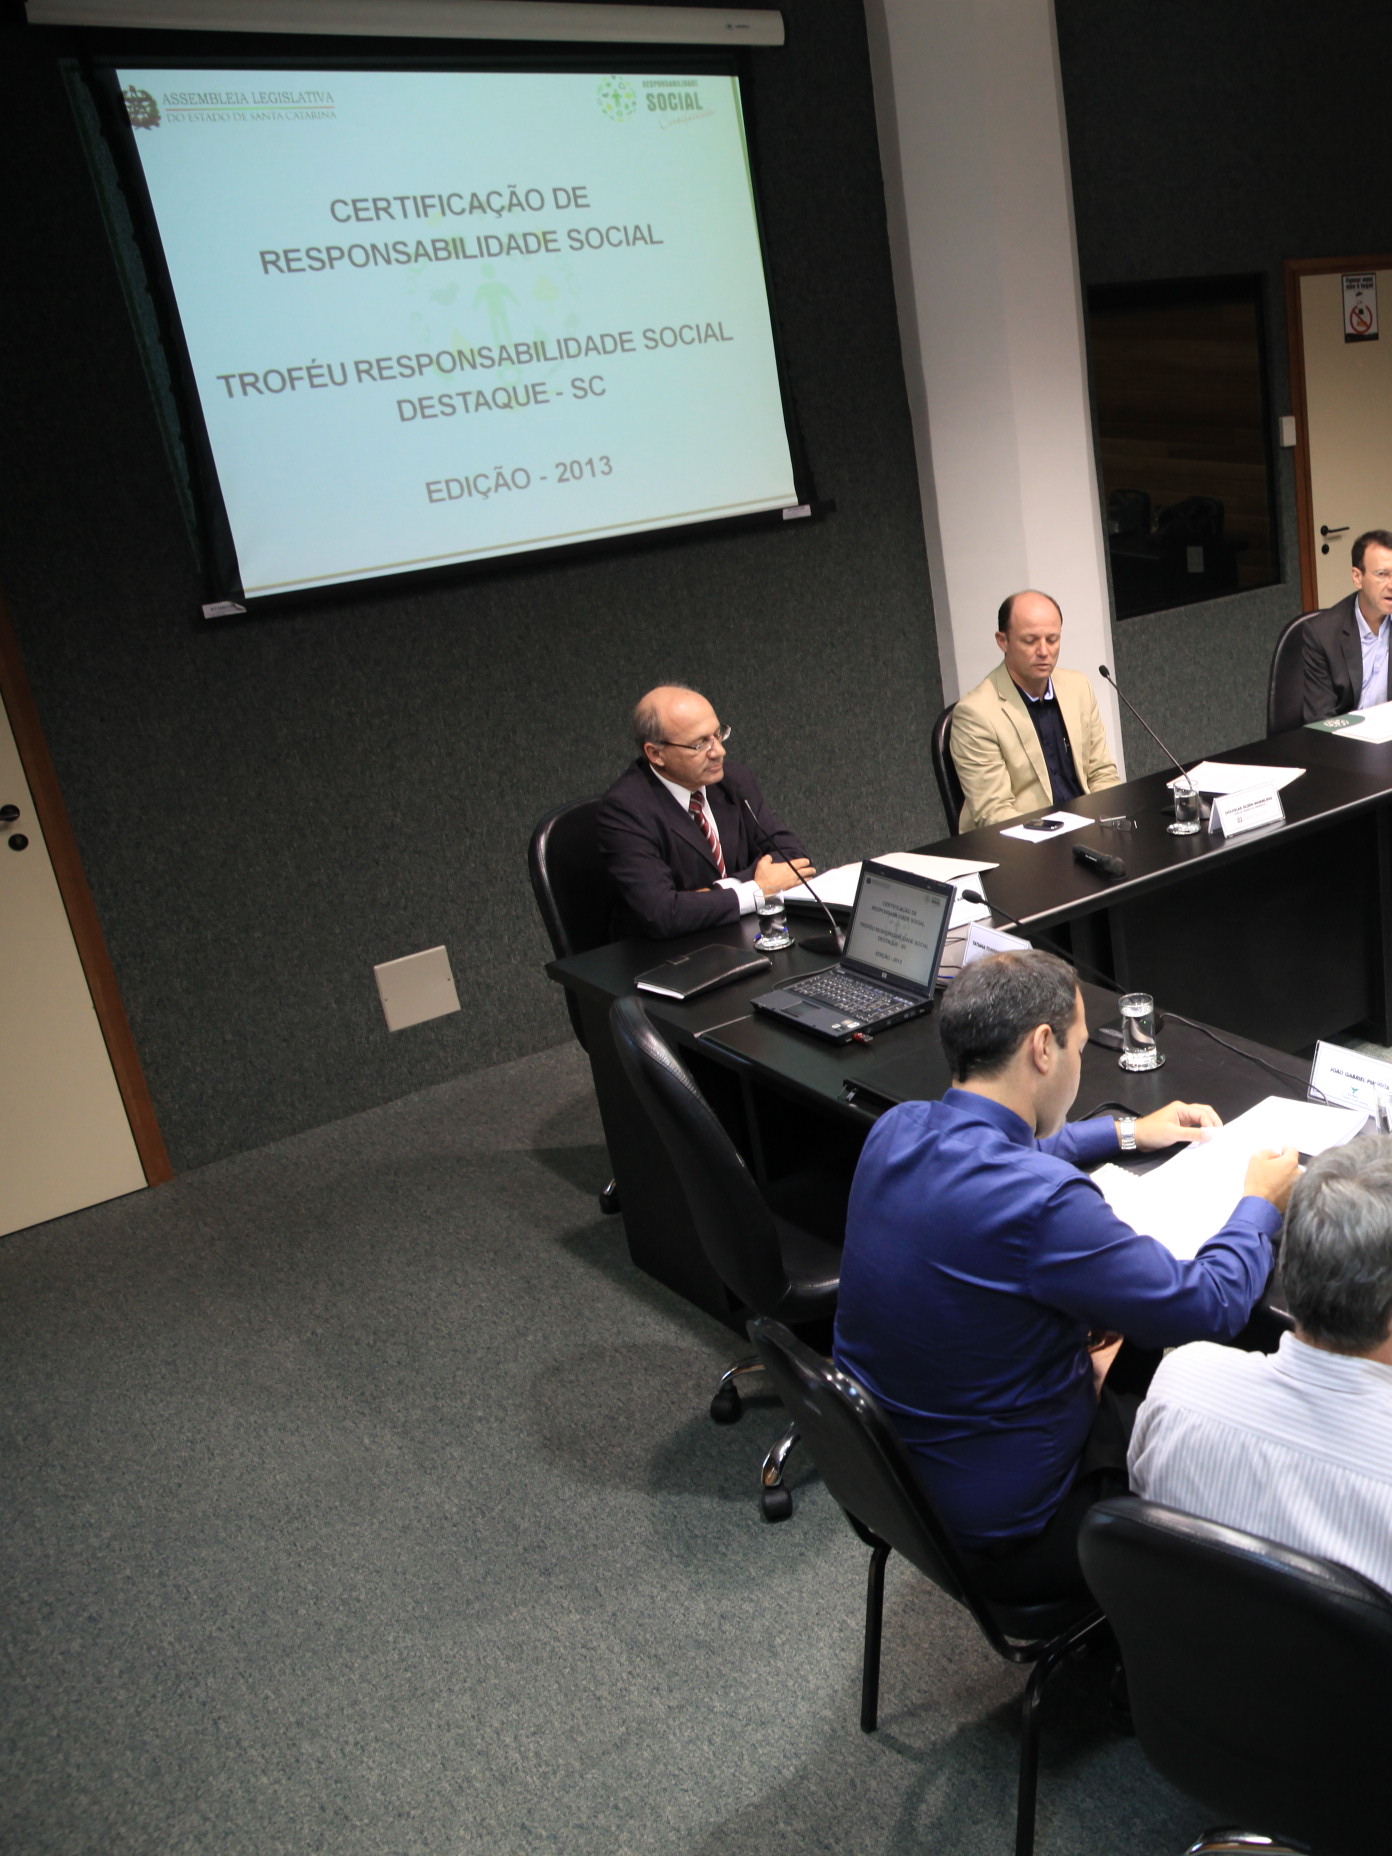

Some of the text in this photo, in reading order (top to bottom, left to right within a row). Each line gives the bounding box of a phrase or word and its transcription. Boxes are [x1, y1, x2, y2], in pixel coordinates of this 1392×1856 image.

[162, 90, 335, 106] ASSEMBLEIA LEGISLATIVA
[166, 110, 337, 123] DO ESTADO DE SANTA CATARINA
[645, 91, 704, 112] SOCIAL
[330, 184, 591, 223] CERTIFICAÇÃO DE
[258, 223, 664, 275] RESPONSABILIDADE SOCIAL
[216, 321, 734, 400] TROFÉU RESPONSABILIDADE SOCIAL
[396, 381, 551, 422] DESTAQUE
[570, 375, 608, 400] SC
[425, 465, 532, 504] EDIÇÃO
[554, 454, 614, 485] 2013
